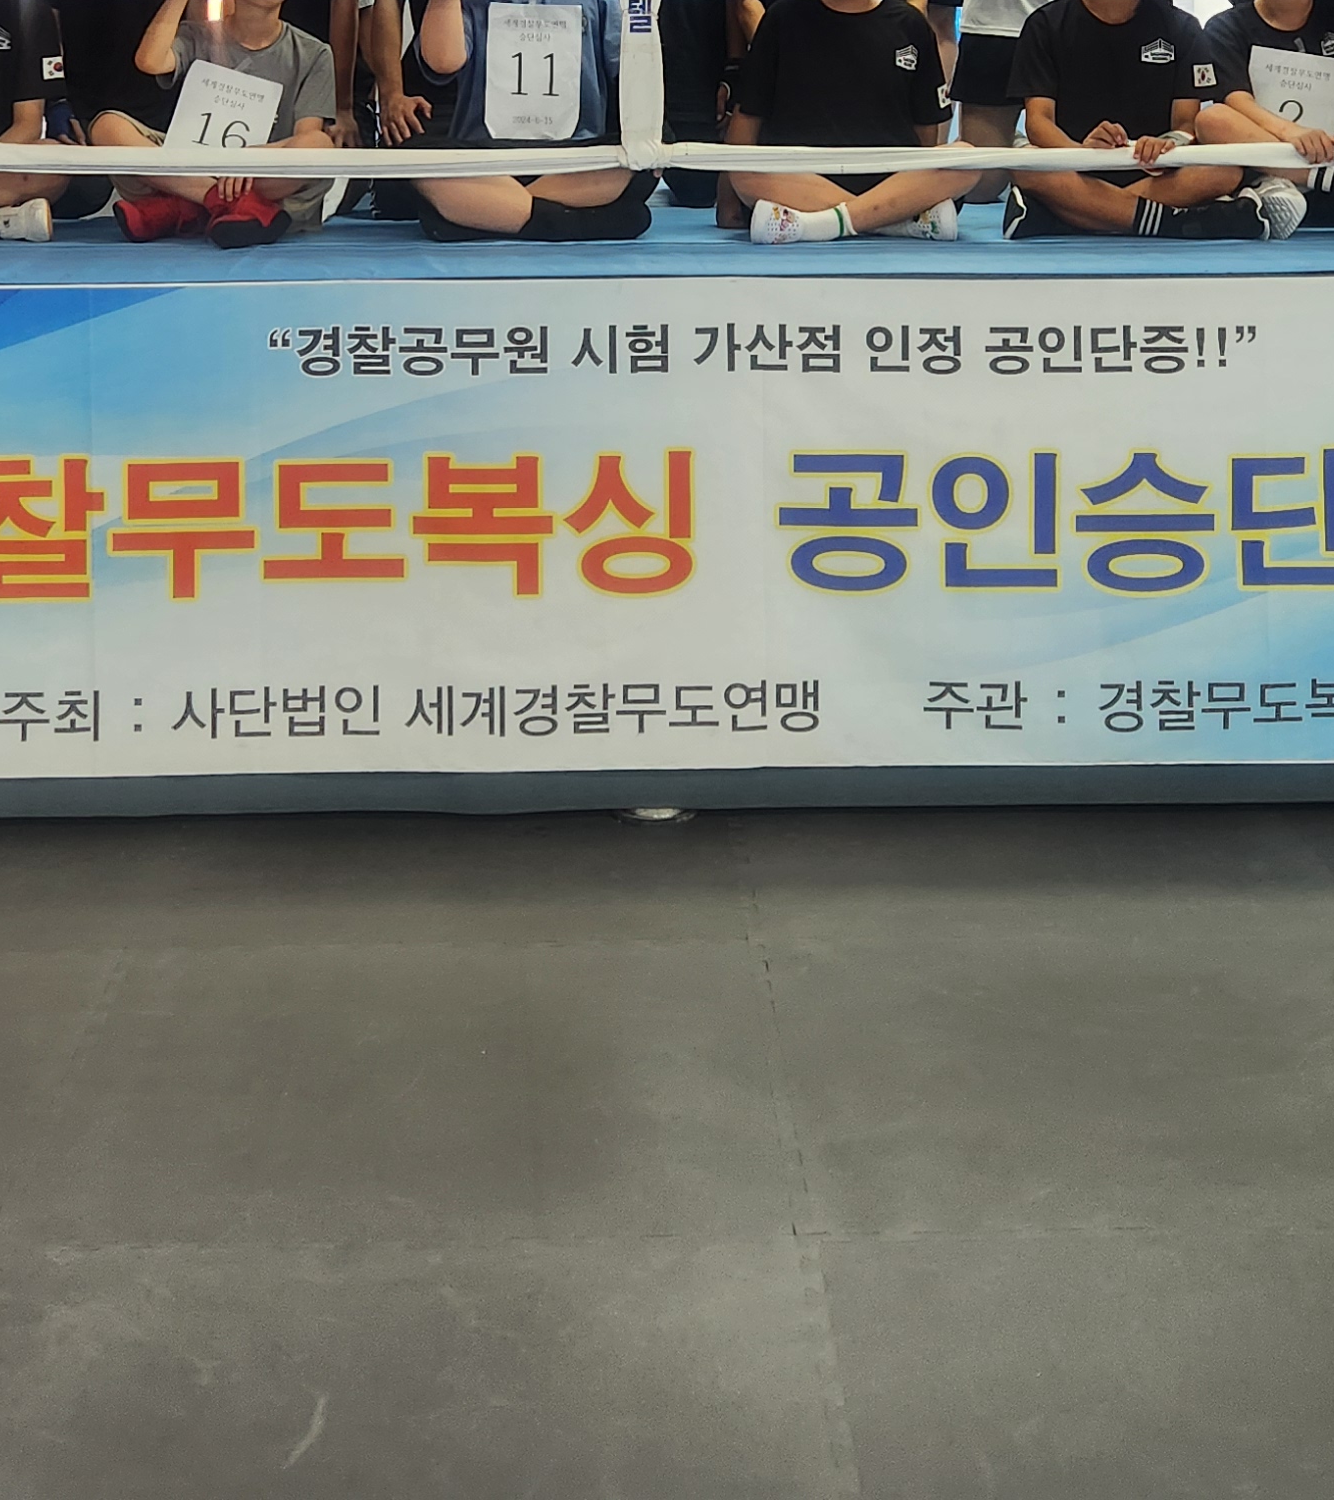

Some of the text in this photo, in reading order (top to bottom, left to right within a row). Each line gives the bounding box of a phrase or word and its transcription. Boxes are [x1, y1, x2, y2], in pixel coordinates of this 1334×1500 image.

[511, 52, 559, 96] 11
[192, 112, 250, 148] 16
[571, 323, 670, 375] 시험
[693, 322, 842, 374] 가산점
[866, 325, 963, 376] 인정
[171, 683, 382, 739] 사단법인
[404, 679, 823, 738] 세계경찰무도연맹
[923, 679, 1027, 731] 주관
